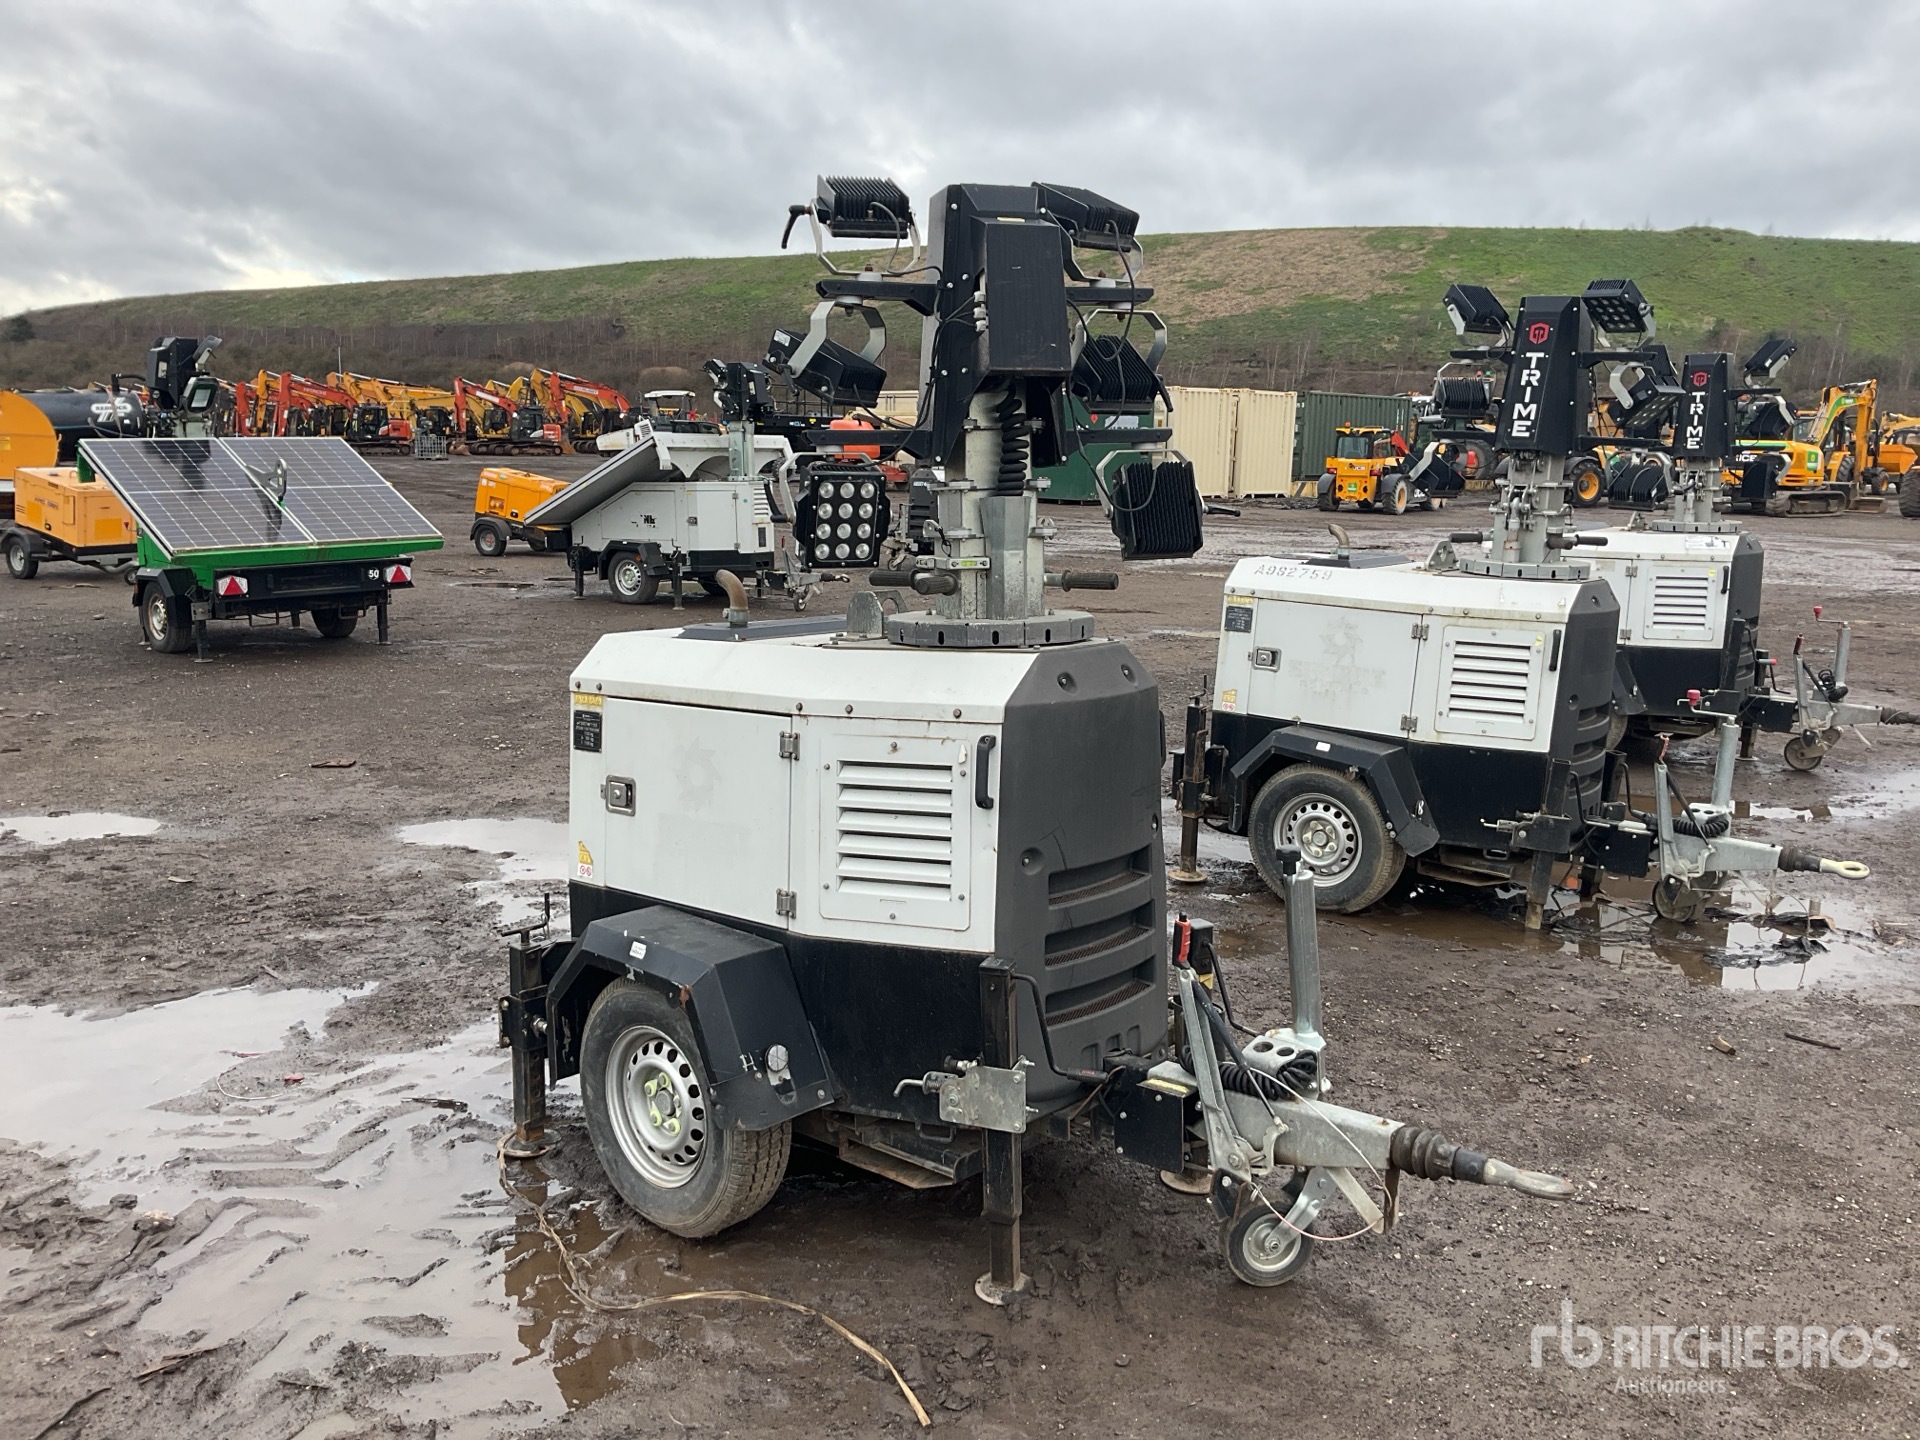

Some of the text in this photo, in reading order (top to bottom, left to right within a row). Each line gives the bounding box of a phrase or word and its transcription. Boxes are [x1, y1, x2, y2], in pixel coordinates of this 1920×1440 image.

[1511, 351, 1545, 438] TRIME
[1686, 391, 1706, 449] TRIME
[368, 569, 380, 579] 50
